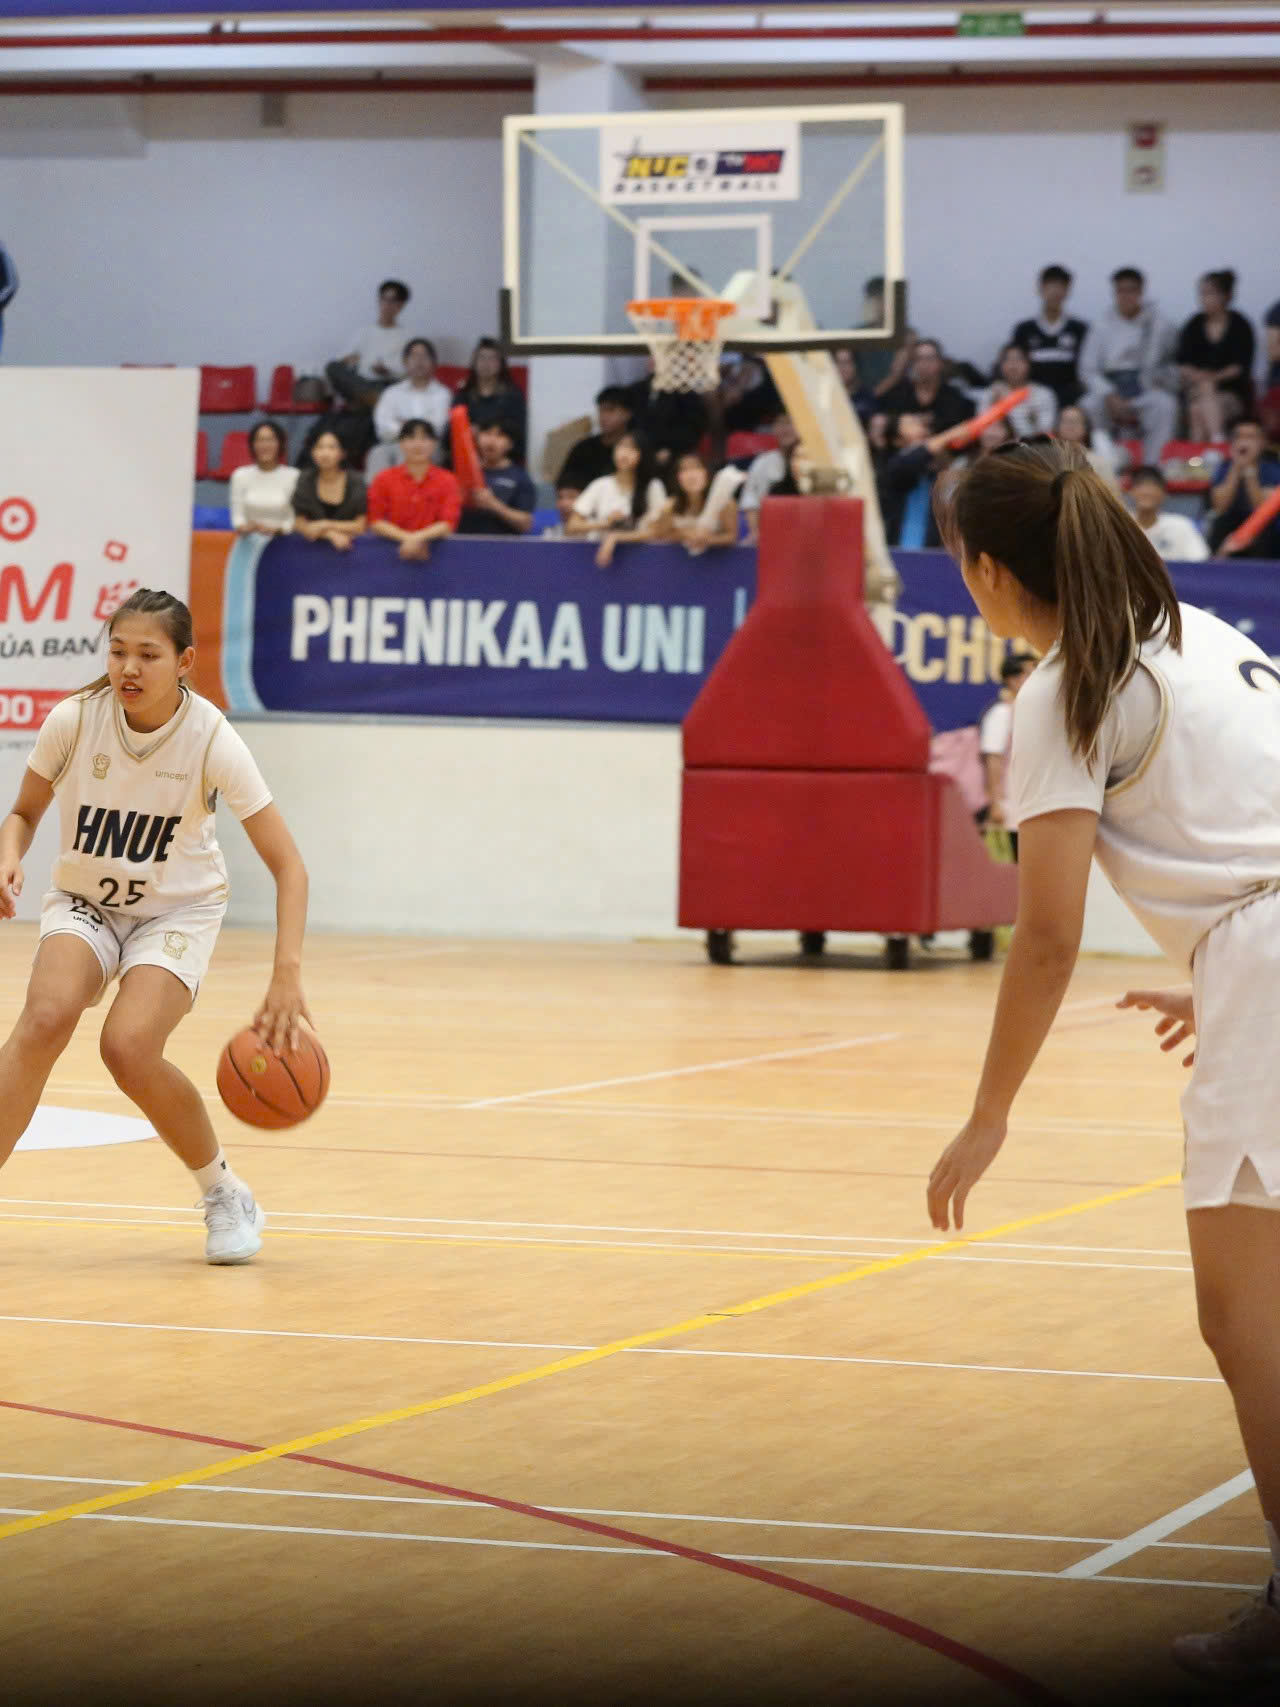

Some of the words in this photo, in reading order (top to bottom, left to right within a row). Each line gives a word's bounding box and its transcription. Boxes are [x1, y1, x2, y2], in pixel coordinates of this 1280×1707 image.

[290, 595, 588, 670] PHENIKAA
[602, 603, 706, 674] UNI
[72, 805, 182, 864] HNUE
[98, 877, 147, 908] 25
